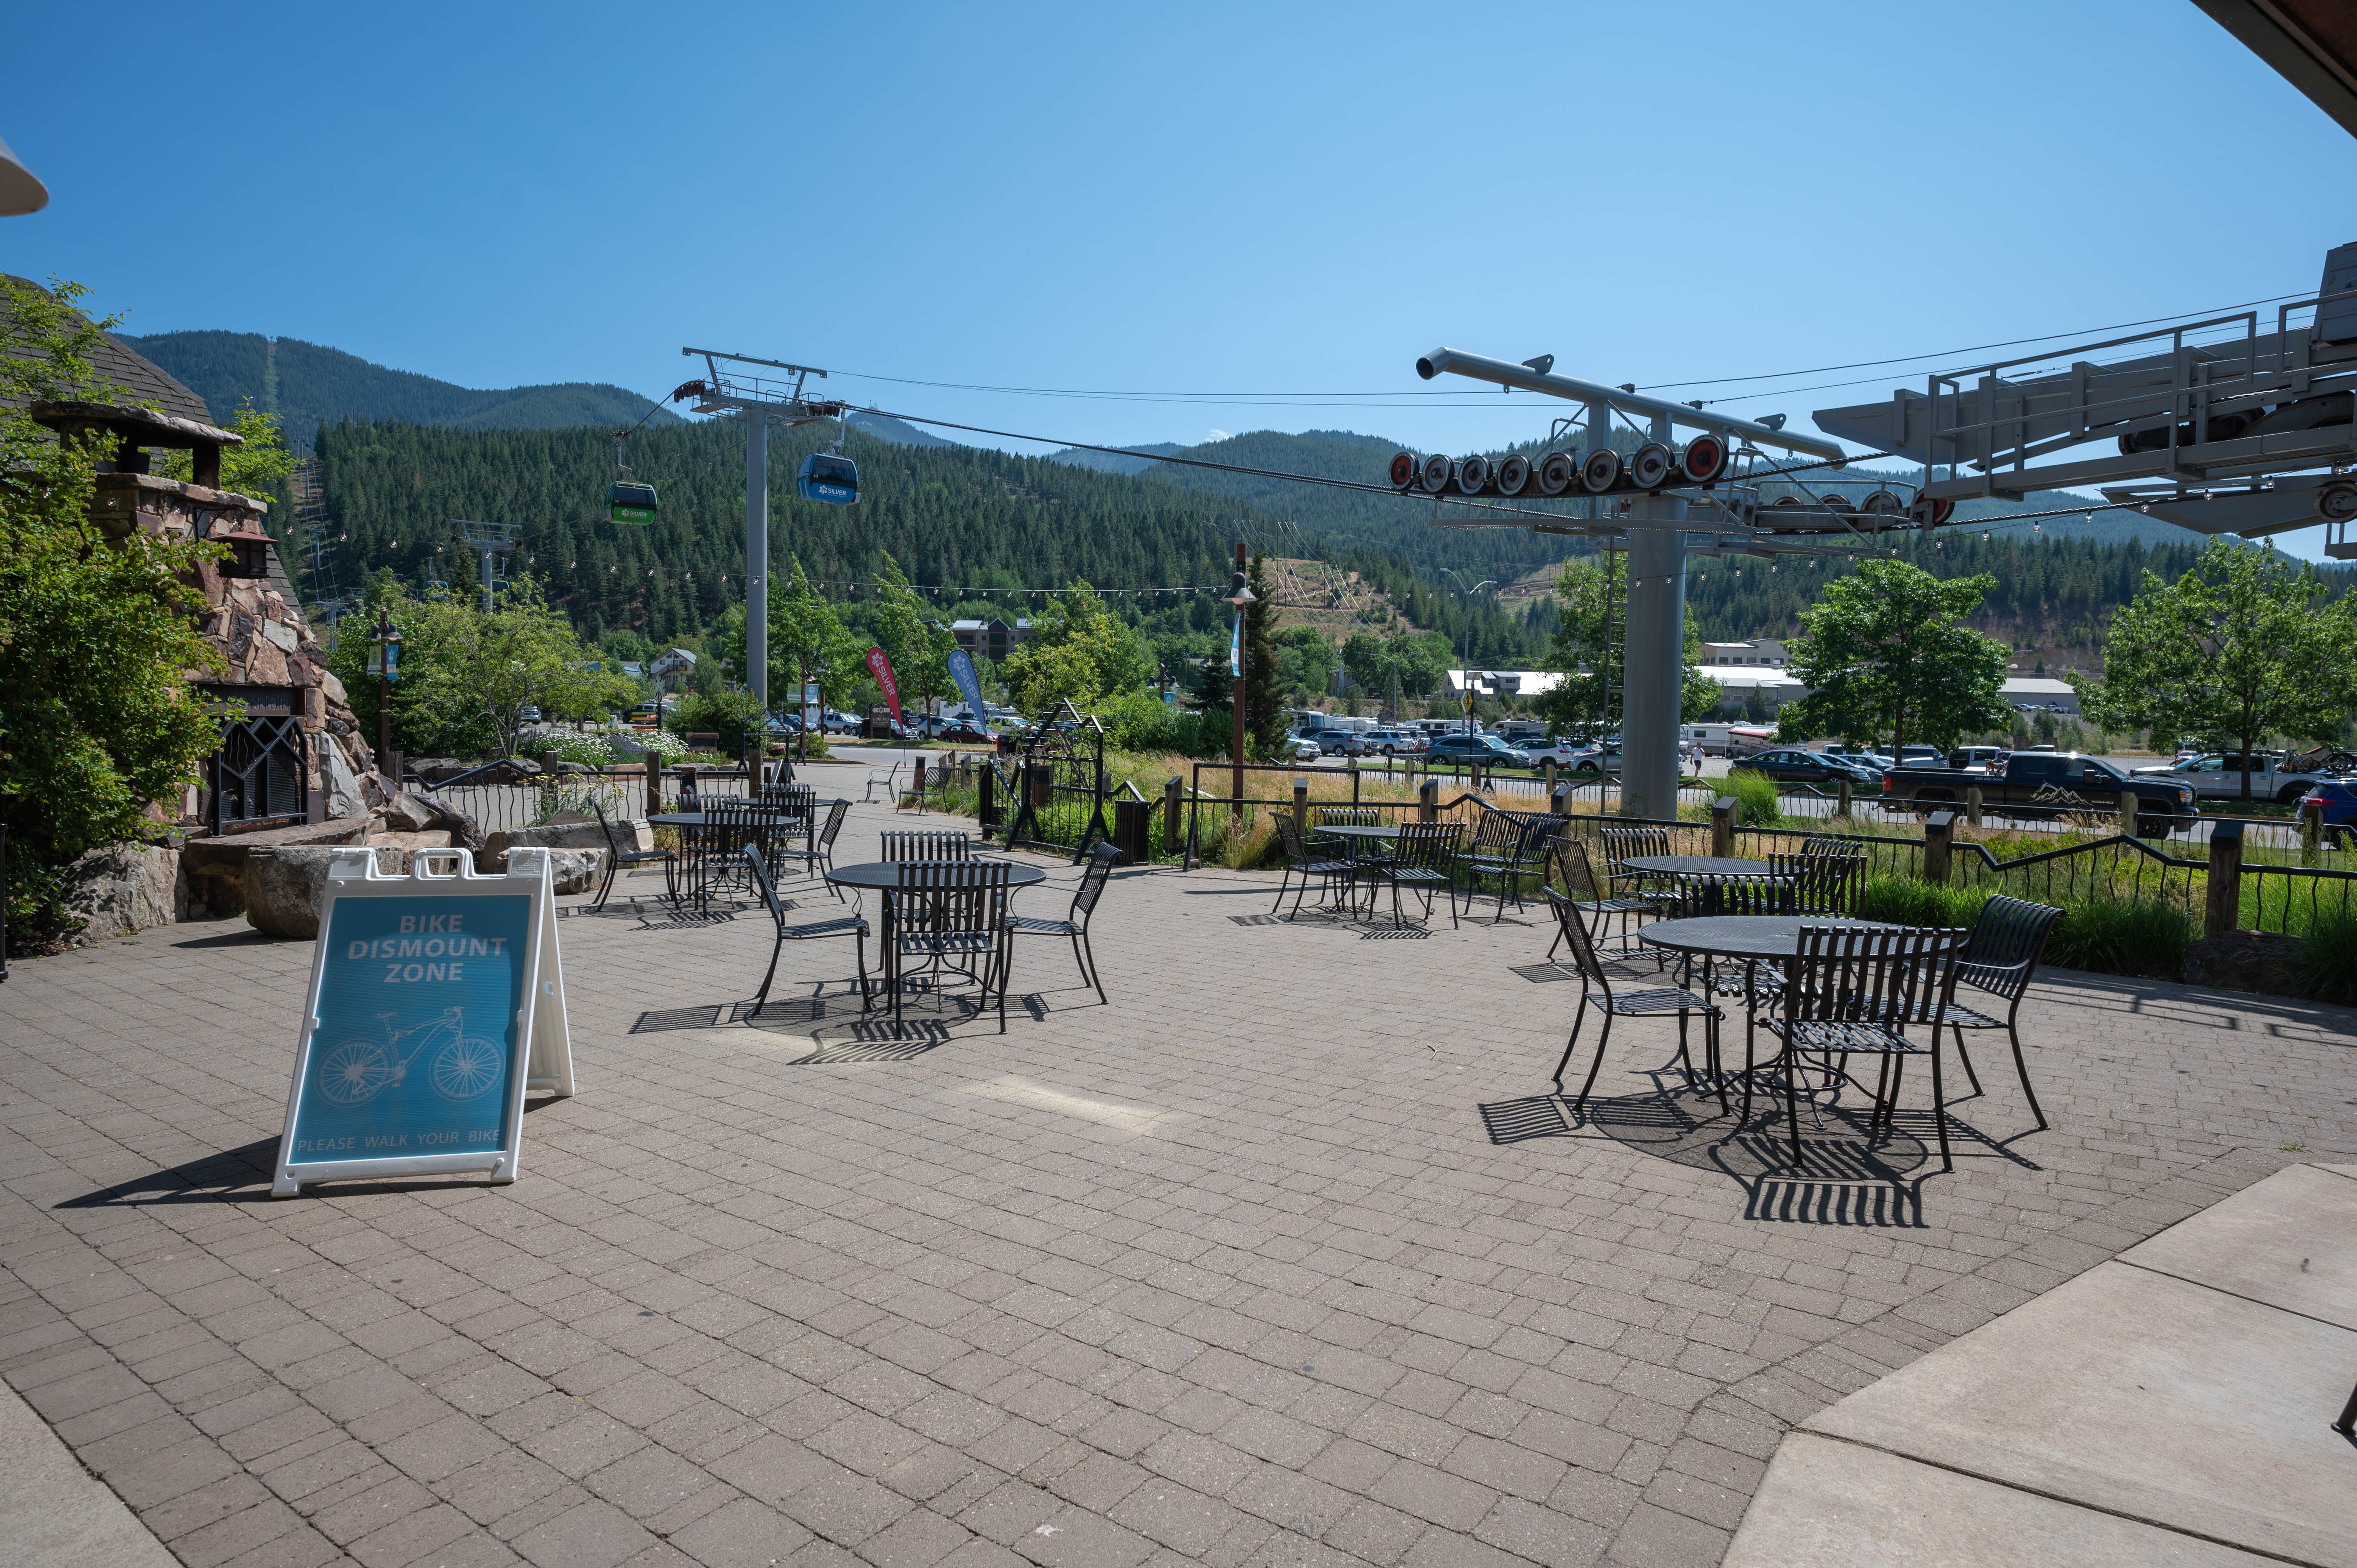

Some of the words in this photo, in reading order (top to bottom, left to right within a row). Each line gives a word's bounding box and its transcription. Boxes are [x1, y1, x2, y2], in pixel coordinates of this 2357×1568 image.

[827, 488, 846, 496] SILVER
[878, 666, 895, 696] SILVER
[960, 669, 979, 700] SILVER
[399, 915, 463, 933] BIKE
[348, 938, 507, 959] DISMOUNT
[383, 962, 464, 982] ZONE
[297, 1137, 356, 1152] PLEASE
[365, 1134, 409, 1148] WALK
[418, 1132, 459, 1145] YOUR
[469, 1130, 501, 1142] BIKE
